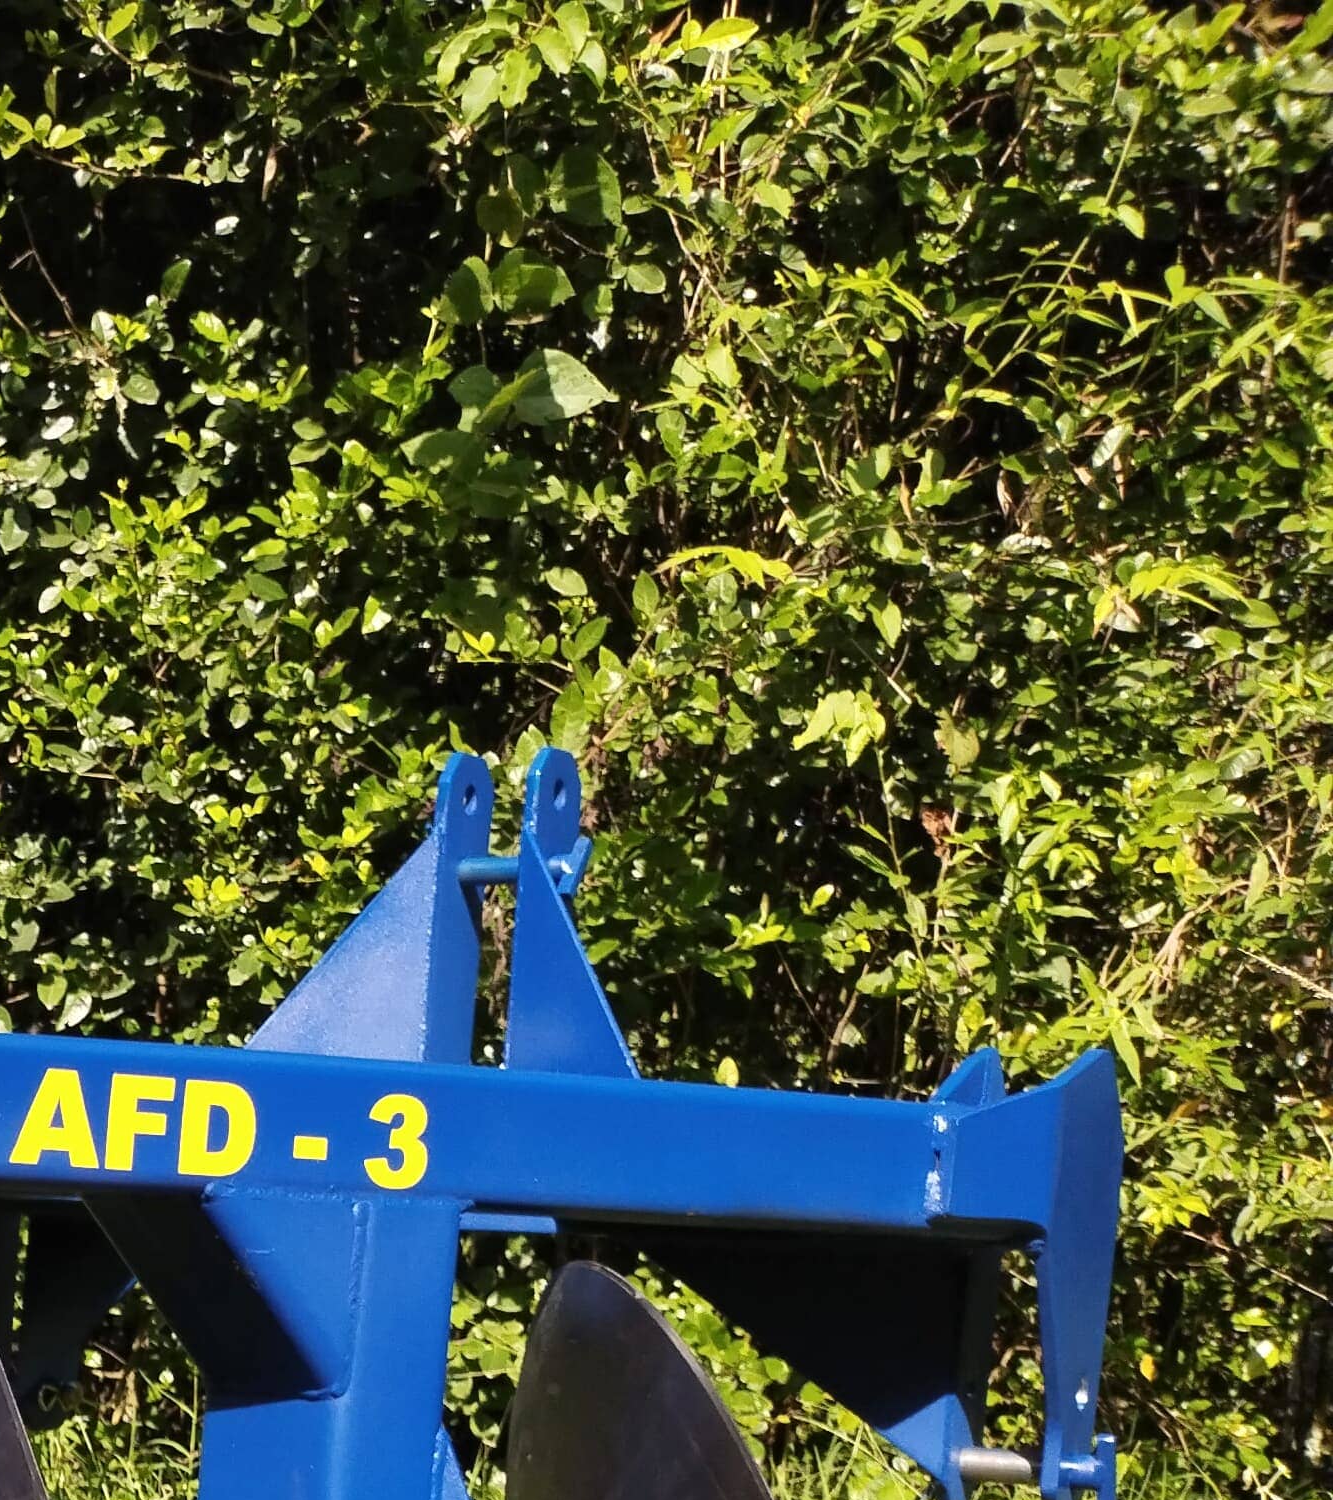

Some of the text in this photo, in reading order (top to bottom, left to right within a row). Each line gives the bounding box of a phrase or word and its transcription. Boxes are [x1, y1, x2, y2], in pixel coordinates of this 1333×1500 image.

[9, 1068, 429, 1190] AFD - 3
